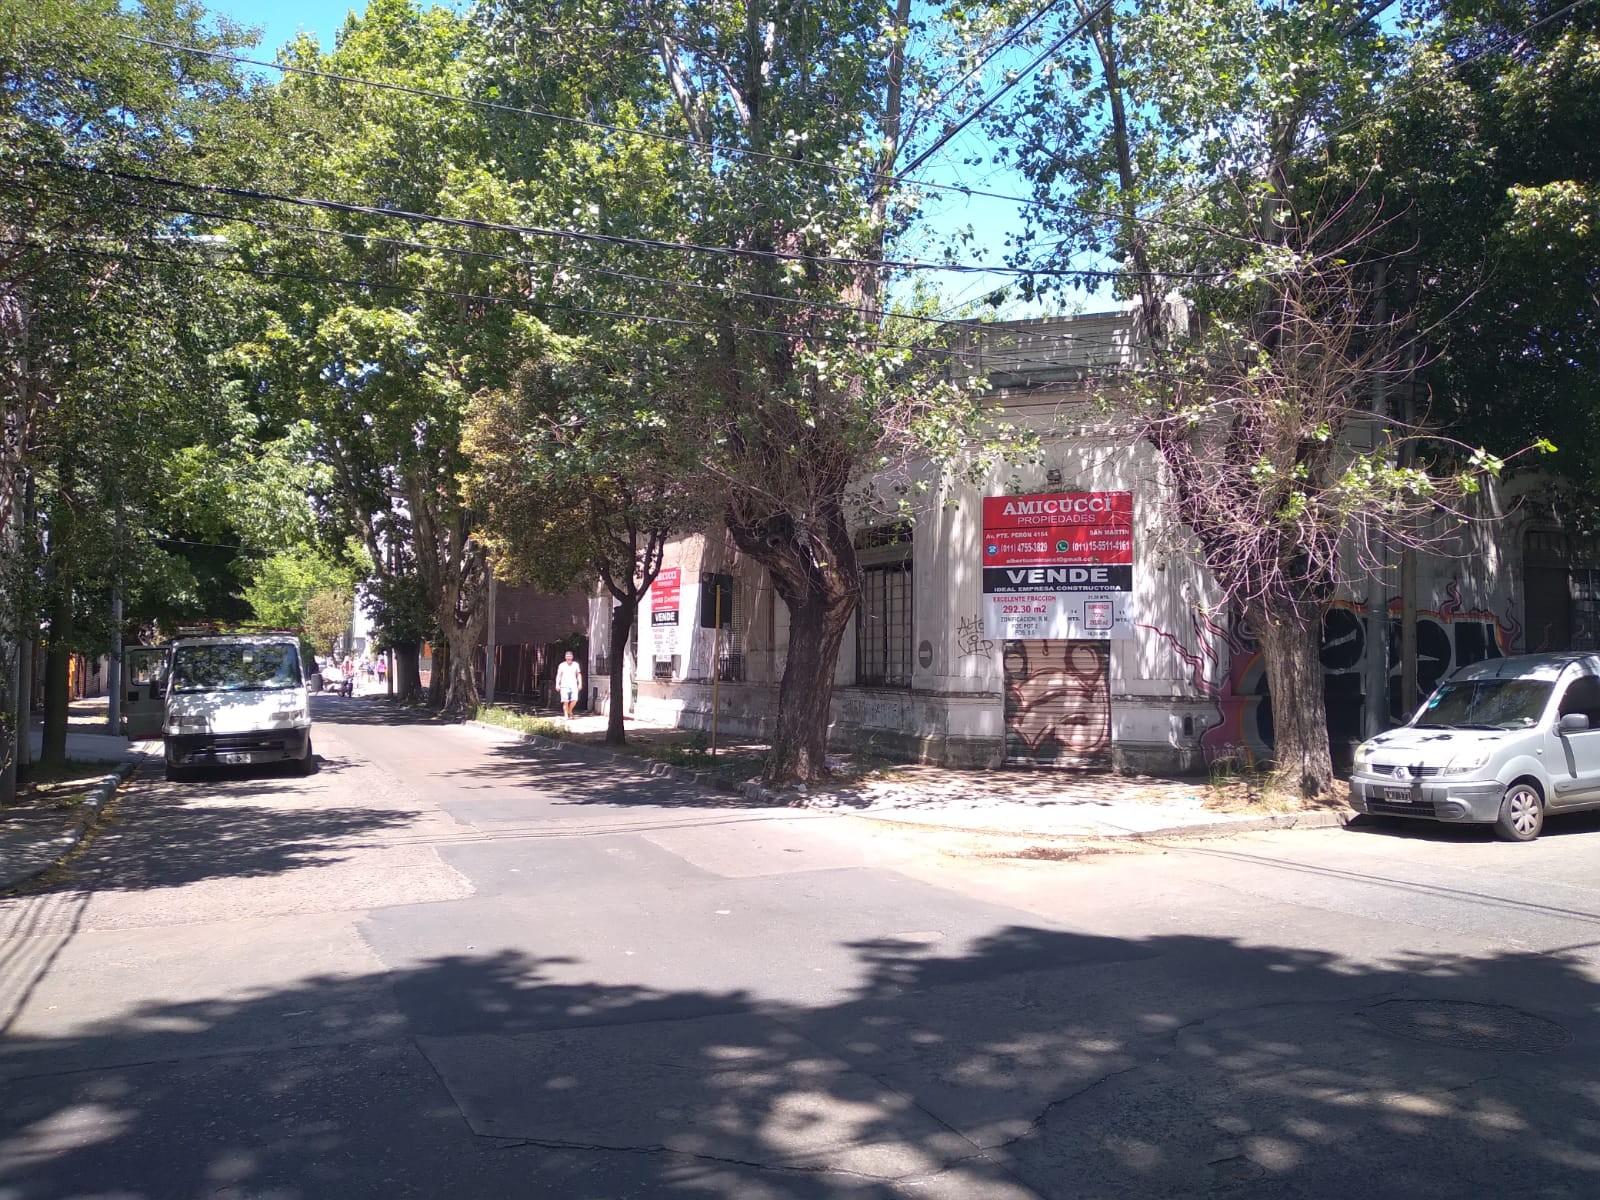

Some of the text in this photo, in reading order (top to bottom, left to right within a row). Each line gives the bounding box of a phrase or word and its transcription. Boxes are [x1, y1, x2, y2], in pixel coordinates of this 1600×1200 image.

[1002, 498, 1112, 515] AMICUCCI
[1017, 514, 1096, 524] PROPIEDADES
[1000, 543, 1017, 553] (011)
[1072, 542, 1088, 552] (011)
[1006, 568, 1109, 584] VENDE
[1003, 604, 1047, 613] 292.30 m2
[655, 612, 676, 622] VENDE
